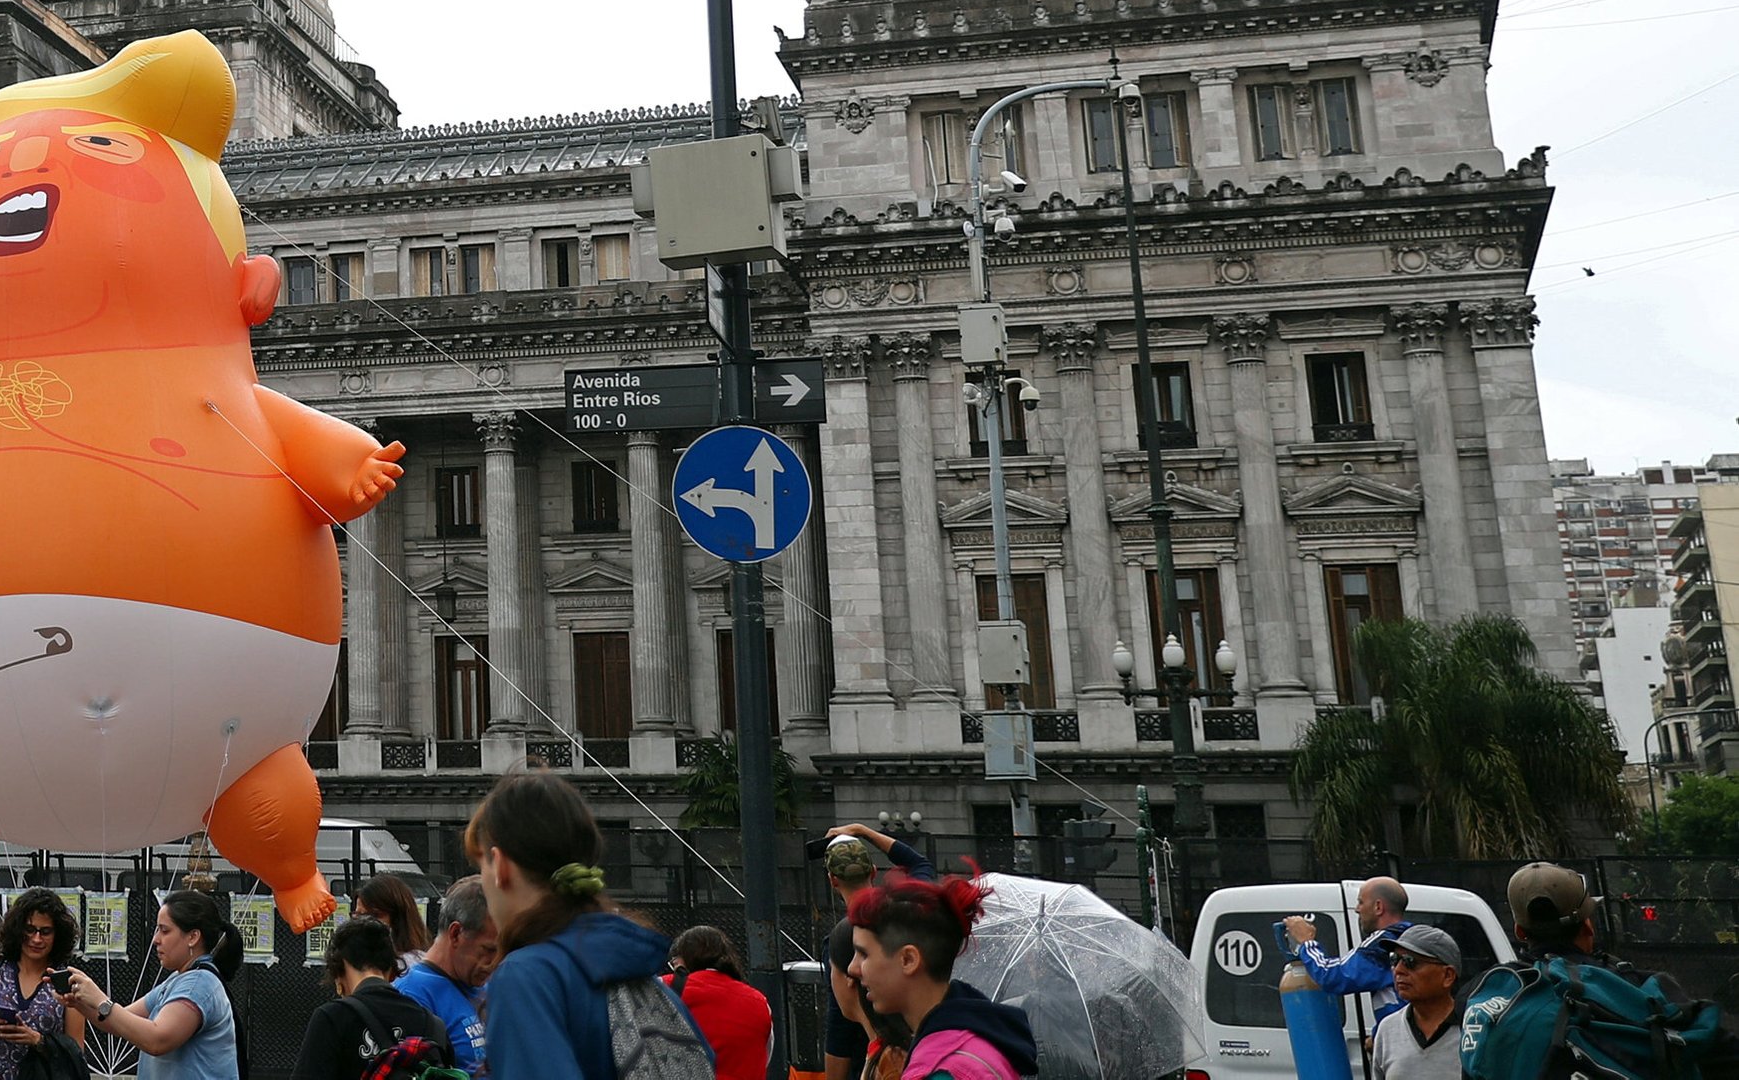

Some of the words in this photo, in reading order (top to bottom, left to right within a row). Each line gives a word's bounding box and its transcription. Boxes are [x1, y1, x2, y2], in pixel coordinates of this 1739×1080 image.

[572, 372, 641, 389] Avenida
[573, 393, 619, 408] Entre
[623, 391, 661, 406] Ríos
[573, 414, 601, 429] 100
[616, 413, 627, 428] 0
[1218, 938, 1258, 968] 110
[1219, 1048, 1272, 1057] PEUGEOT
